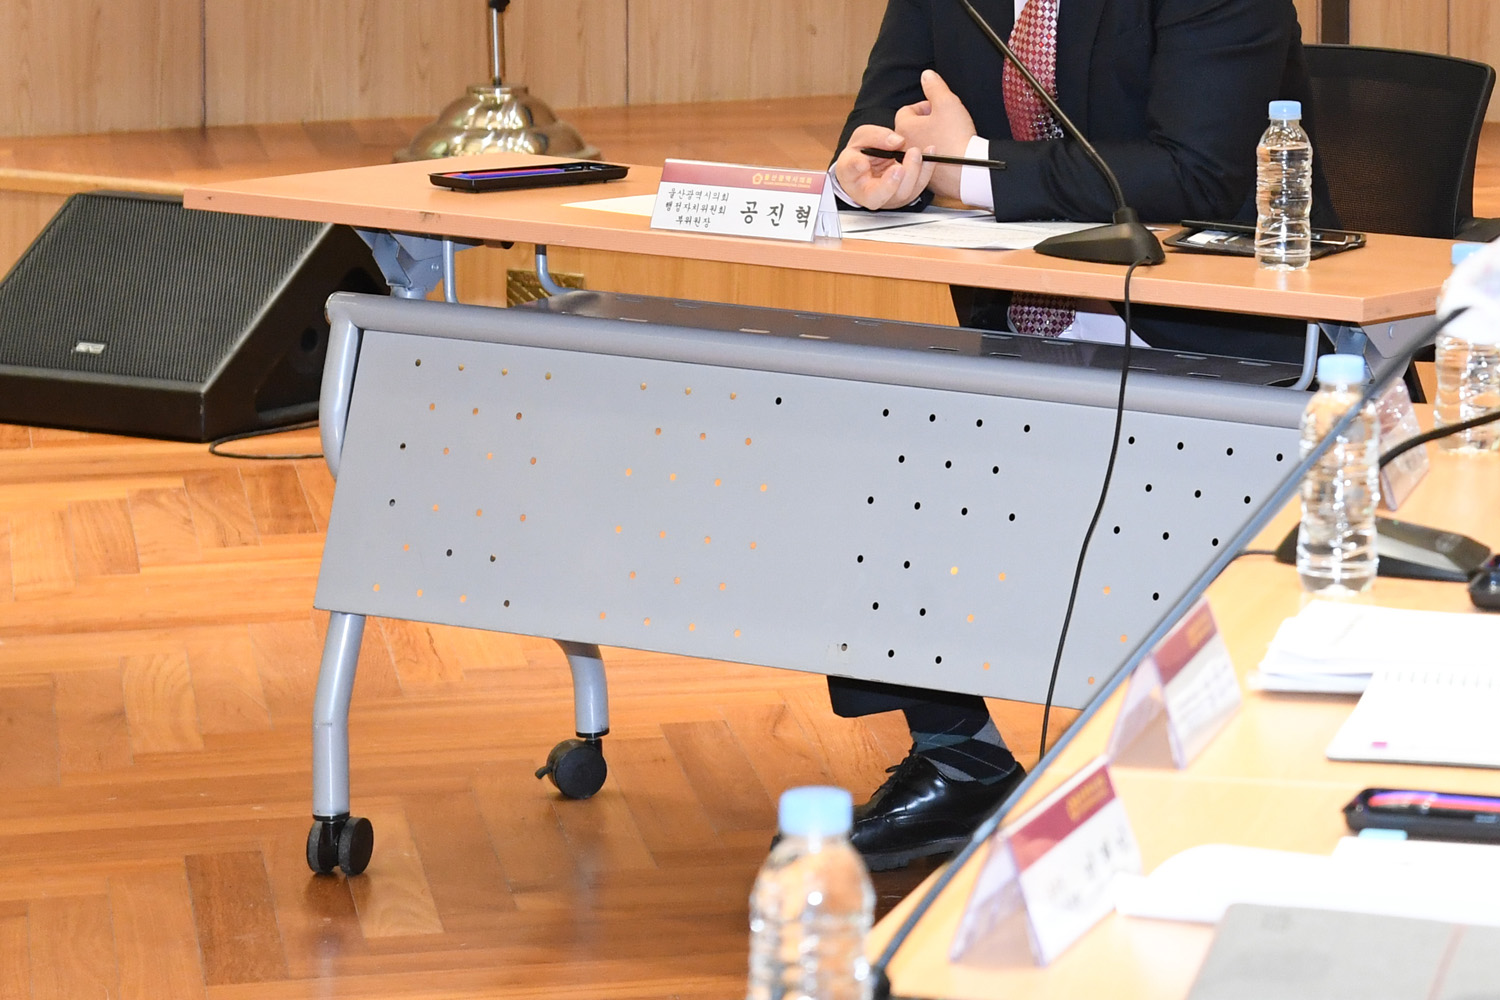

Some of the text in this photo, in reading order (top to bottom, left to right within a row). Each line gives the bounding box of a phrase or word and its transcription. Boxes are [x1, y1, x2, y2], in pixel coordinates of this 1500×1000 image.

[668, 187, 730, 202] 울산광역시의회
[665, 200, 727, 215] 행정자치위원회
[675, 215, 711, 228] 부위원장
